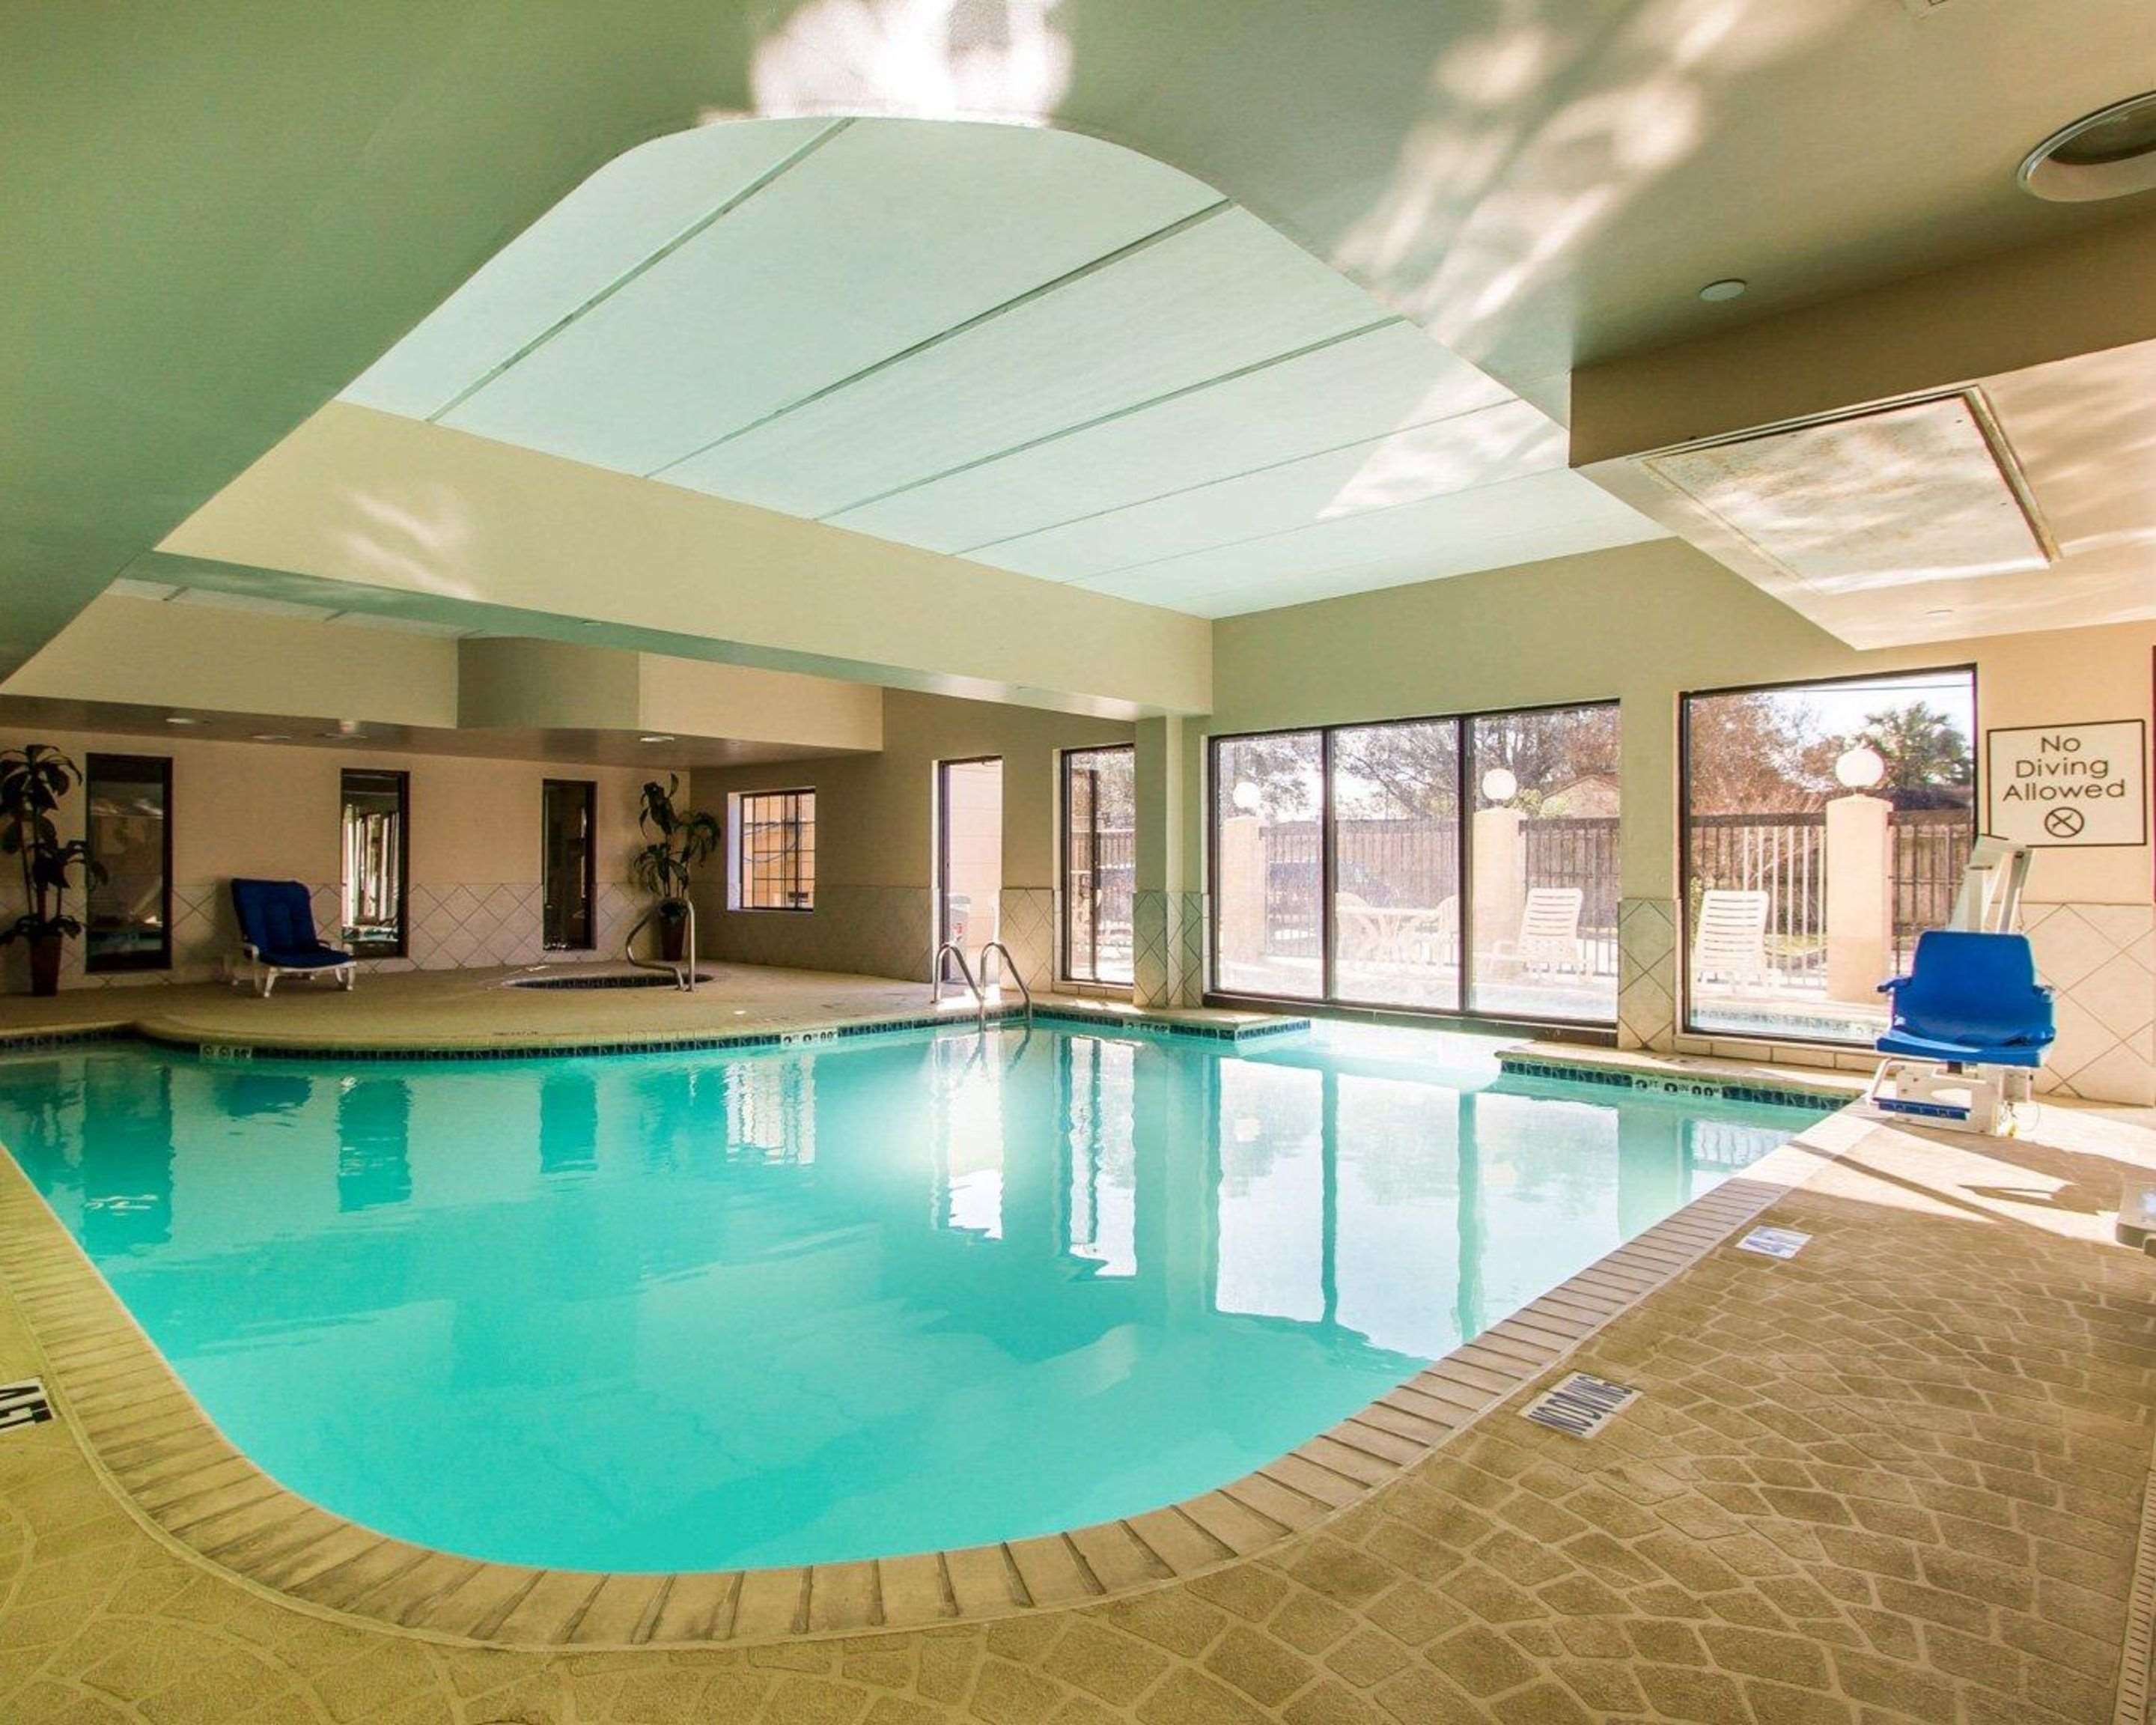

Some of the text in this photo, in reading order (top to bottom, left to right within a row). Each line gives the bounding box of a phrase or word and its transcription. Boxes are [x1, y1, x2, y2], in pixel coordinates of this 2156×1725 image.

[2041, 735, 2081, 753] No
[2015, 757, 2108, 779] Diving
[2003, 779, 2125, 801] Allowed
[1528, 1375, 1633, 1435] NO DIVING
